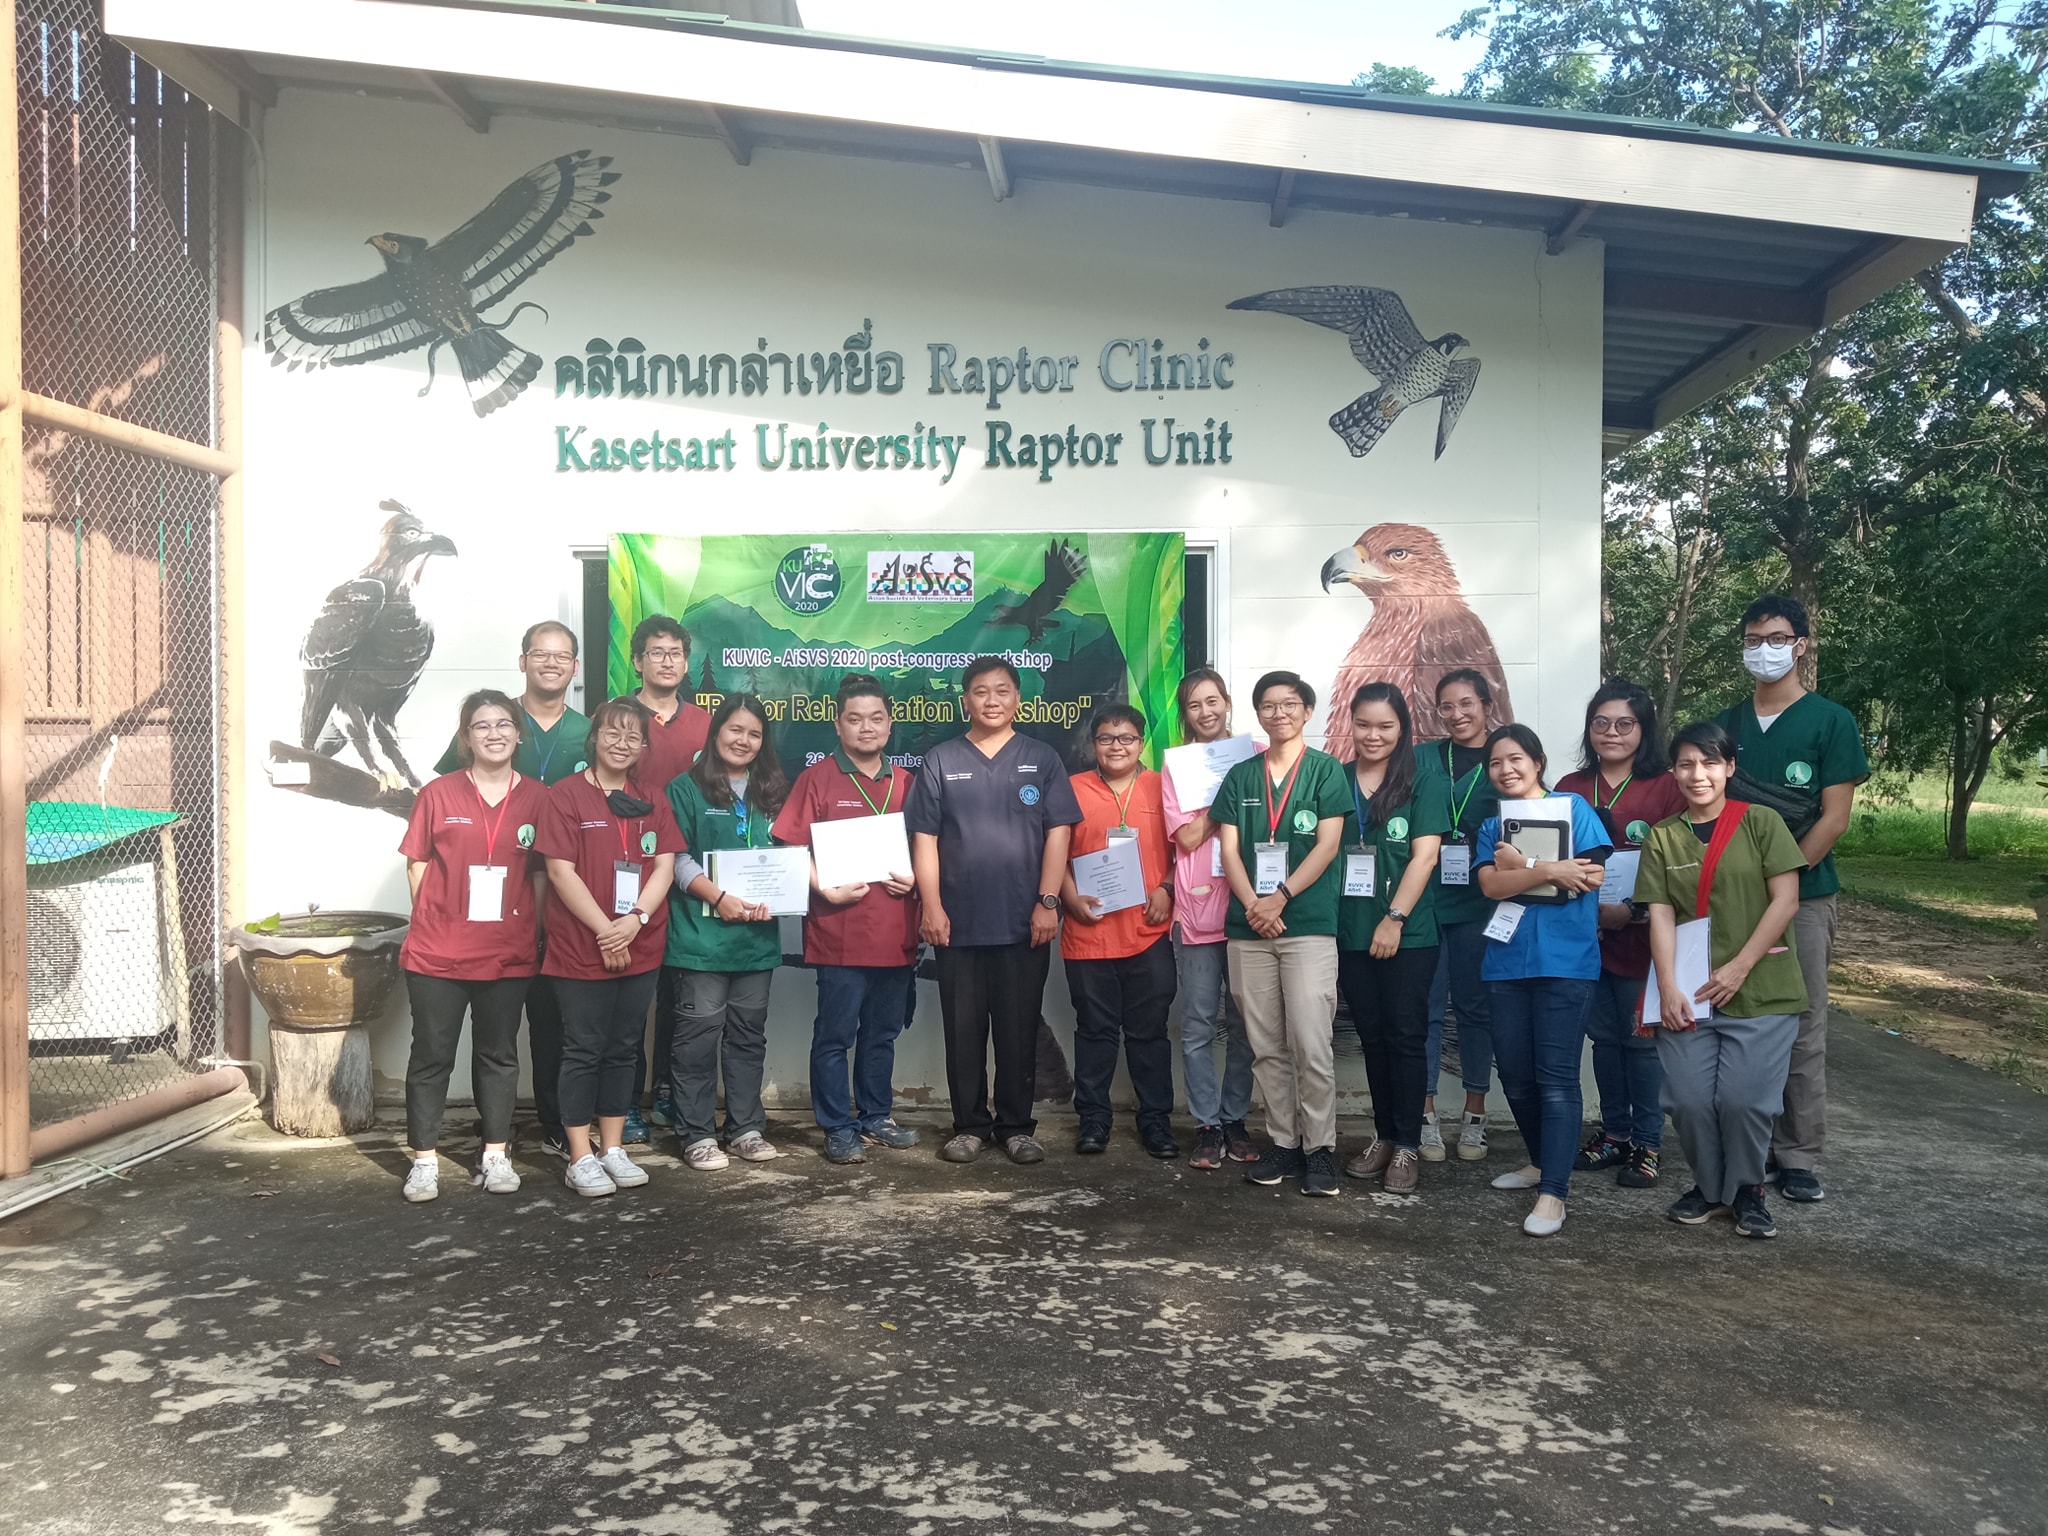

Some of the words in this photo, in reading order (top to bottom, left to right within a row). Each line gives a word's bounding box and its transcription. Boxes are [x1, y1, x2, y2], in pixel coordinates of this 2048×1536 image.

[555, 318, 904, 397] คลินิกนกล่าเหยื่อ
[927, 342, 1079, 409] Raptor
[1098, 338, 1234, 391] Clinic
[554, 425, 737, 471] Kasetsart
[755, 421, 966, 482] University
[985, 420, 1123, 481] Raptor
[1140, 417, 1233, 464] Unit
[782, 559, 803, 572] KU
[795, 601, 819, 611] 2020
[723, 648, 772, 667] KUVIC
[782, 648, 829, 667] AiSVS
[831, 648, 867, 667] 2020
[869, 649, 976, 671] post-congress
